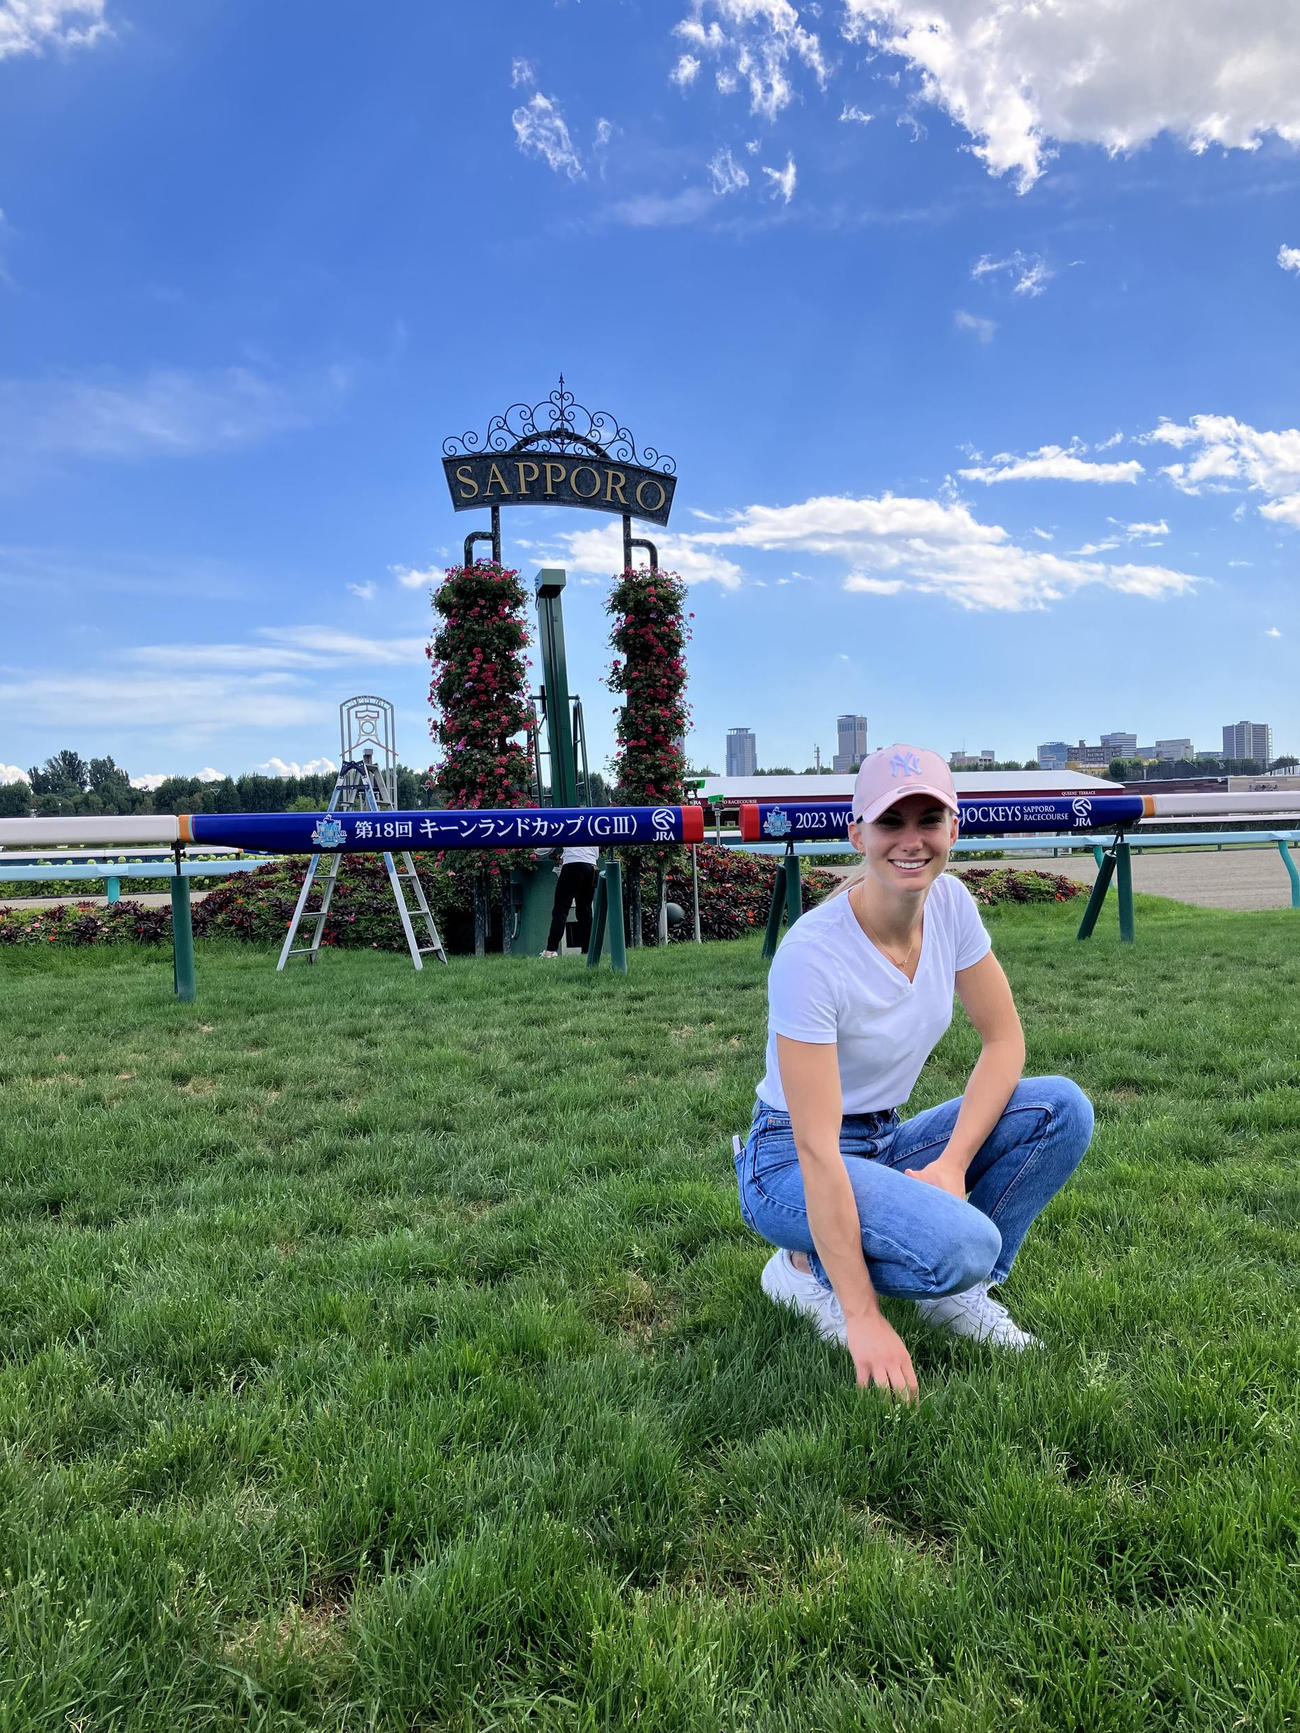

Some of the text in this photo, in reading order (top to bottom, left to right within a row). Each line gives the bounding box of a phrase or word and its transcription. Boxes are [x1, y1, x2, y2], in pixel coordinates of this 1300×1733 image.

[456, 463, 666, 510] SAPPORO
[1023, 805, 1055, 813] SAPPORO
[796, 812, 827, 829] 2023
[830, 811, 857, 827] WO
[961, 806, 1022, 827] JOCKEYS
[1024, 812, 1068, 821] RACECOURSE
[1073, 817, 1092, 827] JRA
[355, 820, 412, 839] 第18回
[653, 831, 675, 841] JRA
